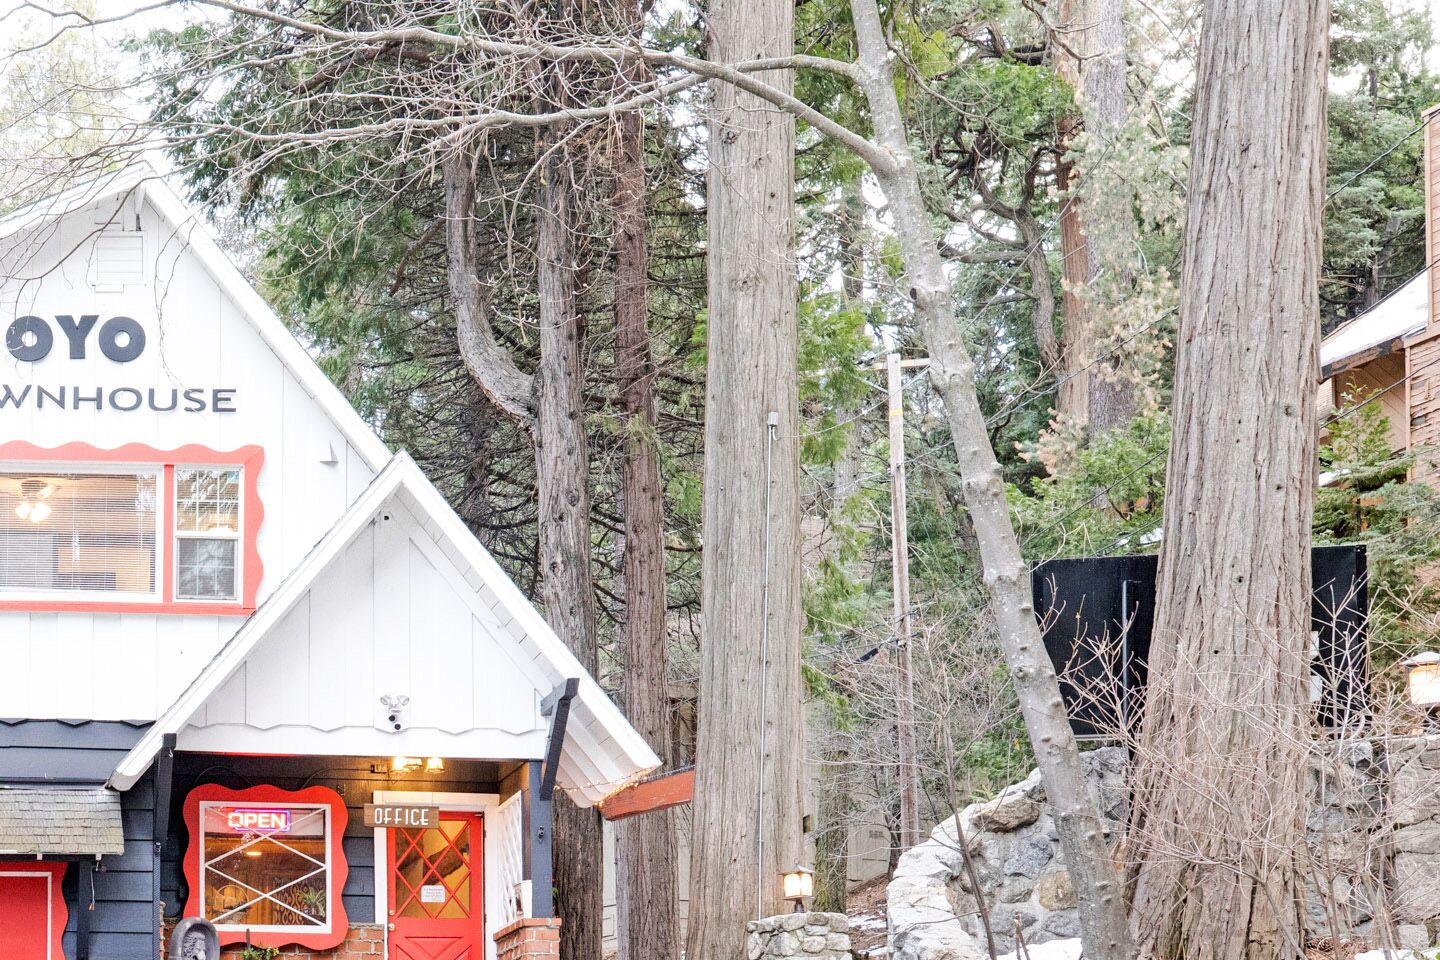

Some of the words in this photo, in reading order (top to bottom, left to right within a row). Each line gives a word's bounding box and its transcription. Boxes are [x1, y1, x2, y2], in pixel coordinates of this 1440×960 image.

[5, 314, 146, 363] OYO
[227, 812, 286, 828] OPEN
[374, 807, 430, 826] OFFICE
